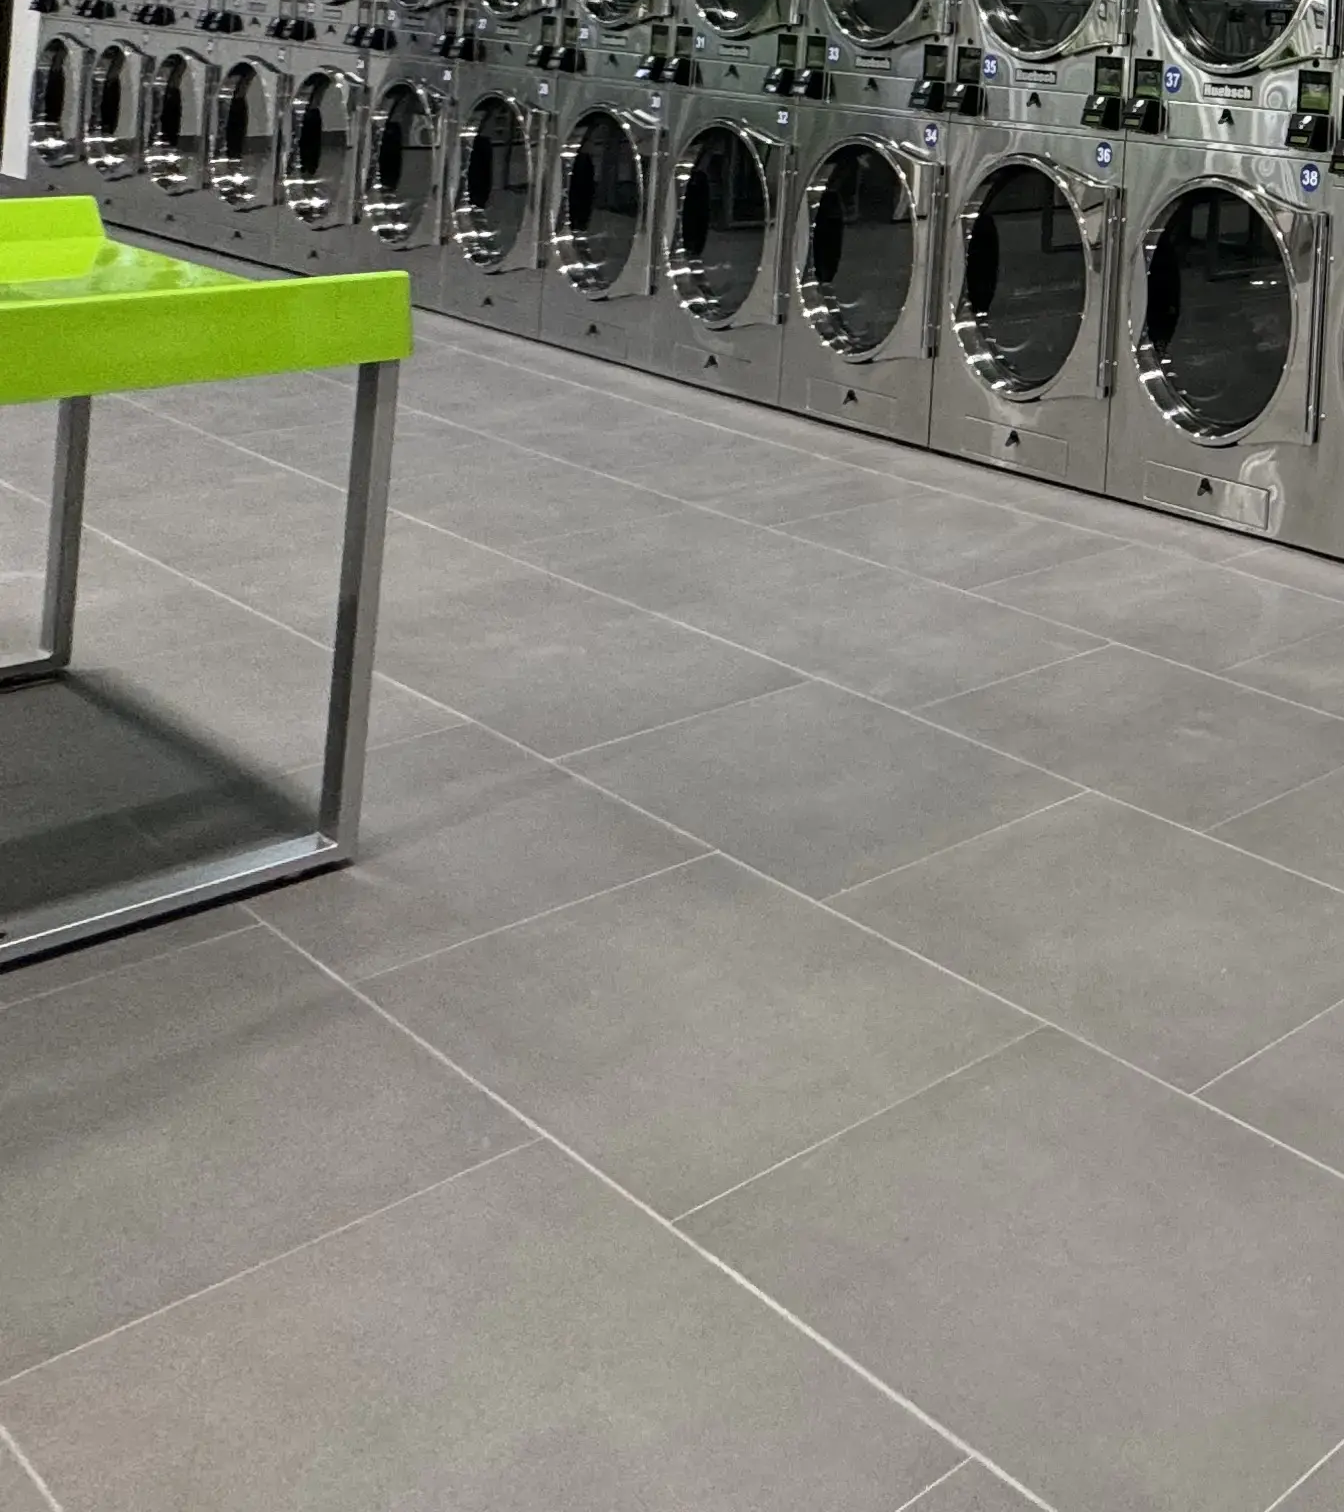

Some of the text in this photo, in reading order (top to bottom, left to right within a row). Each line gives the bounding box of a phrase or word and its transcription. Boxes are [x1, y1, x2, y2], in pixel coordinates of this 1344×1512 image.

[983, 59, 997, 74] 35
[1165, 72, 1181, 88] 37
[924, 127, 937, 144] 34
[1097, 147, 1112, 163] 36
[1301, 169, 1318, 187] 38
